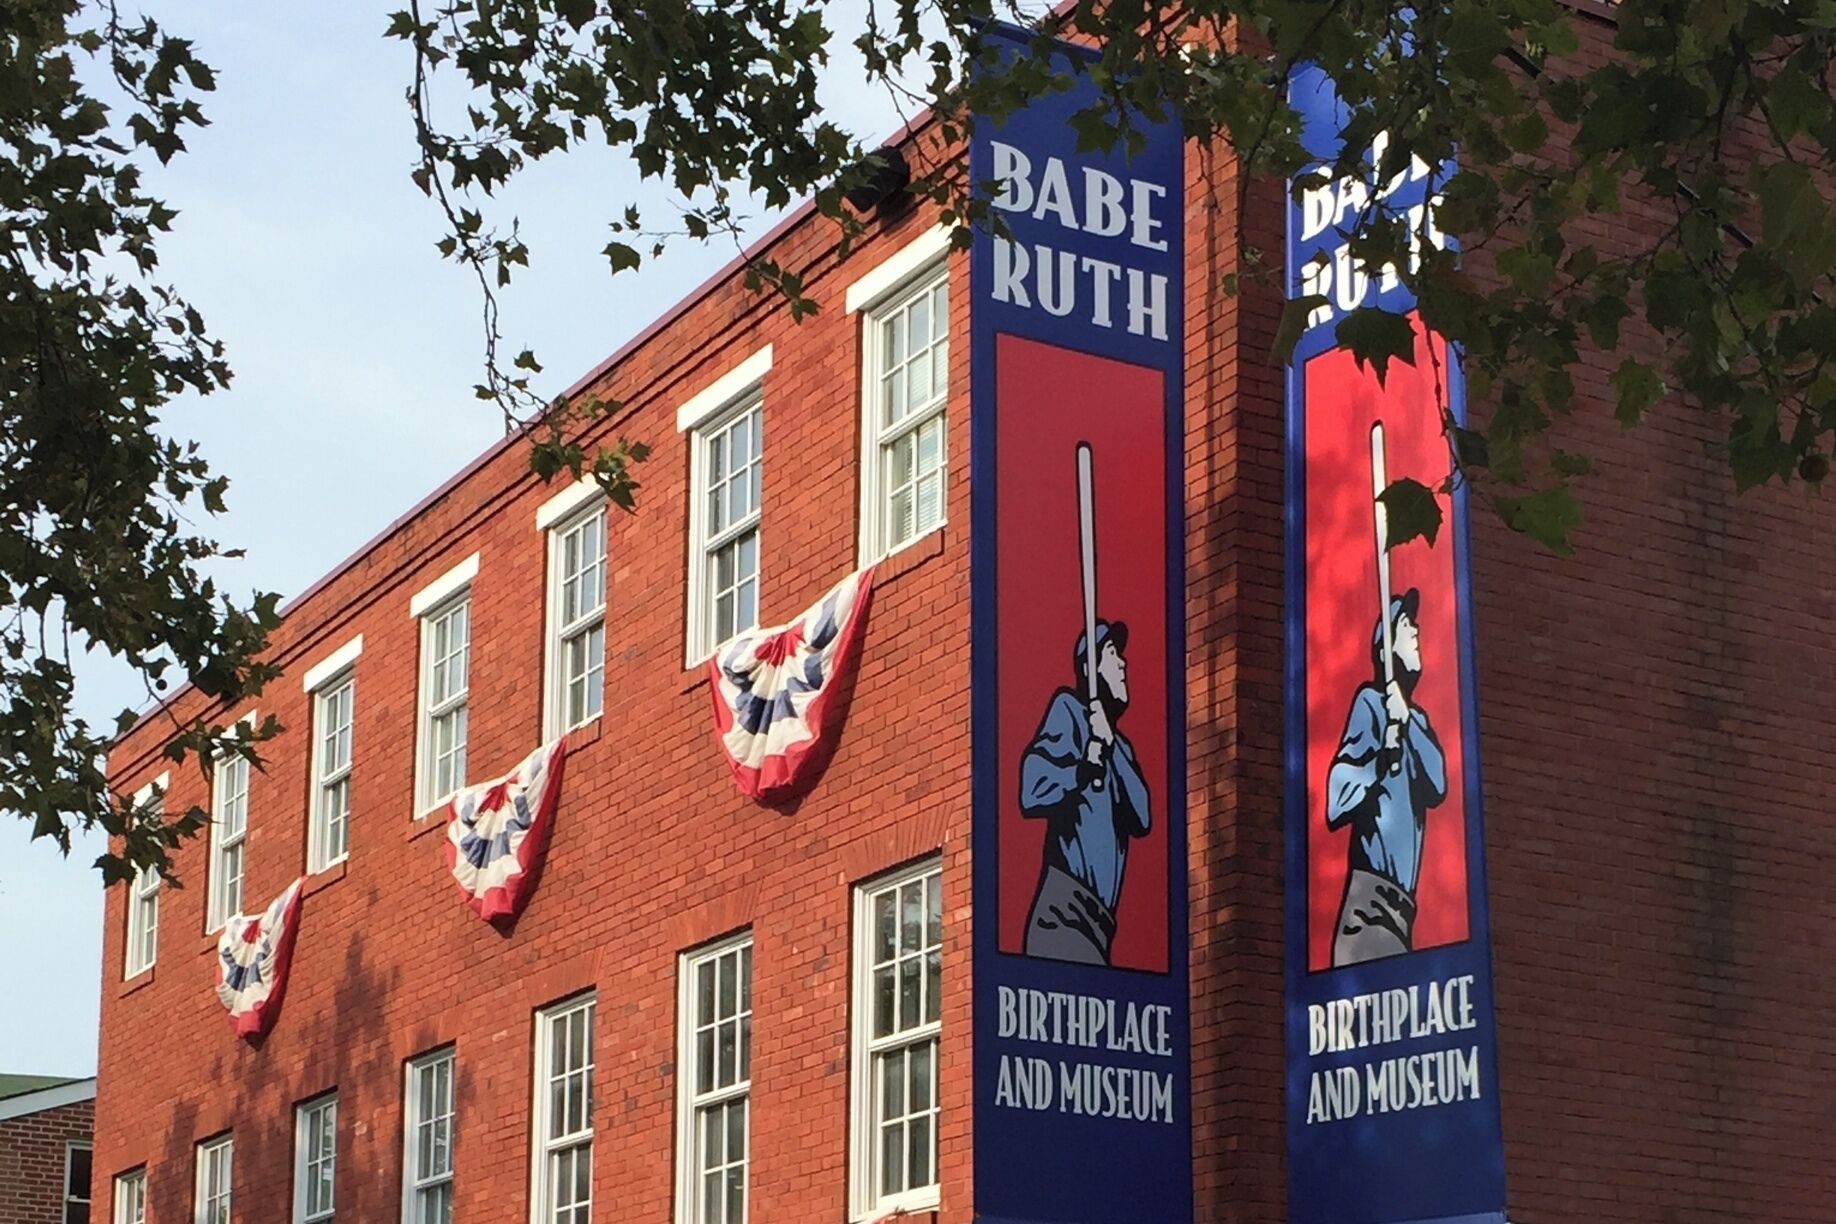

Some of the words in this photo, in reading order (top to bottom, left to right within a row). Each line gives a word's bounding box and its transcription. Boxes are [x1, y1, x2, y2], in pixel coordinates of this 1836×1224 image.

[990, 139, 1169, 252] BABE
[990, 237, 1169, 342] RUTH
[997, 985, 1173, 1057] BIRTHPLACE
[1308, 974, 1477, 1056] BIRTHPLACE
[995, 1054, 1053, 1110] AND
[1059, 1060, 1174, 1124] MUSEUM
[1306, 1066, 1361, 1125] AND
[1365, 1046, 1480, 1115] MUSEUM
